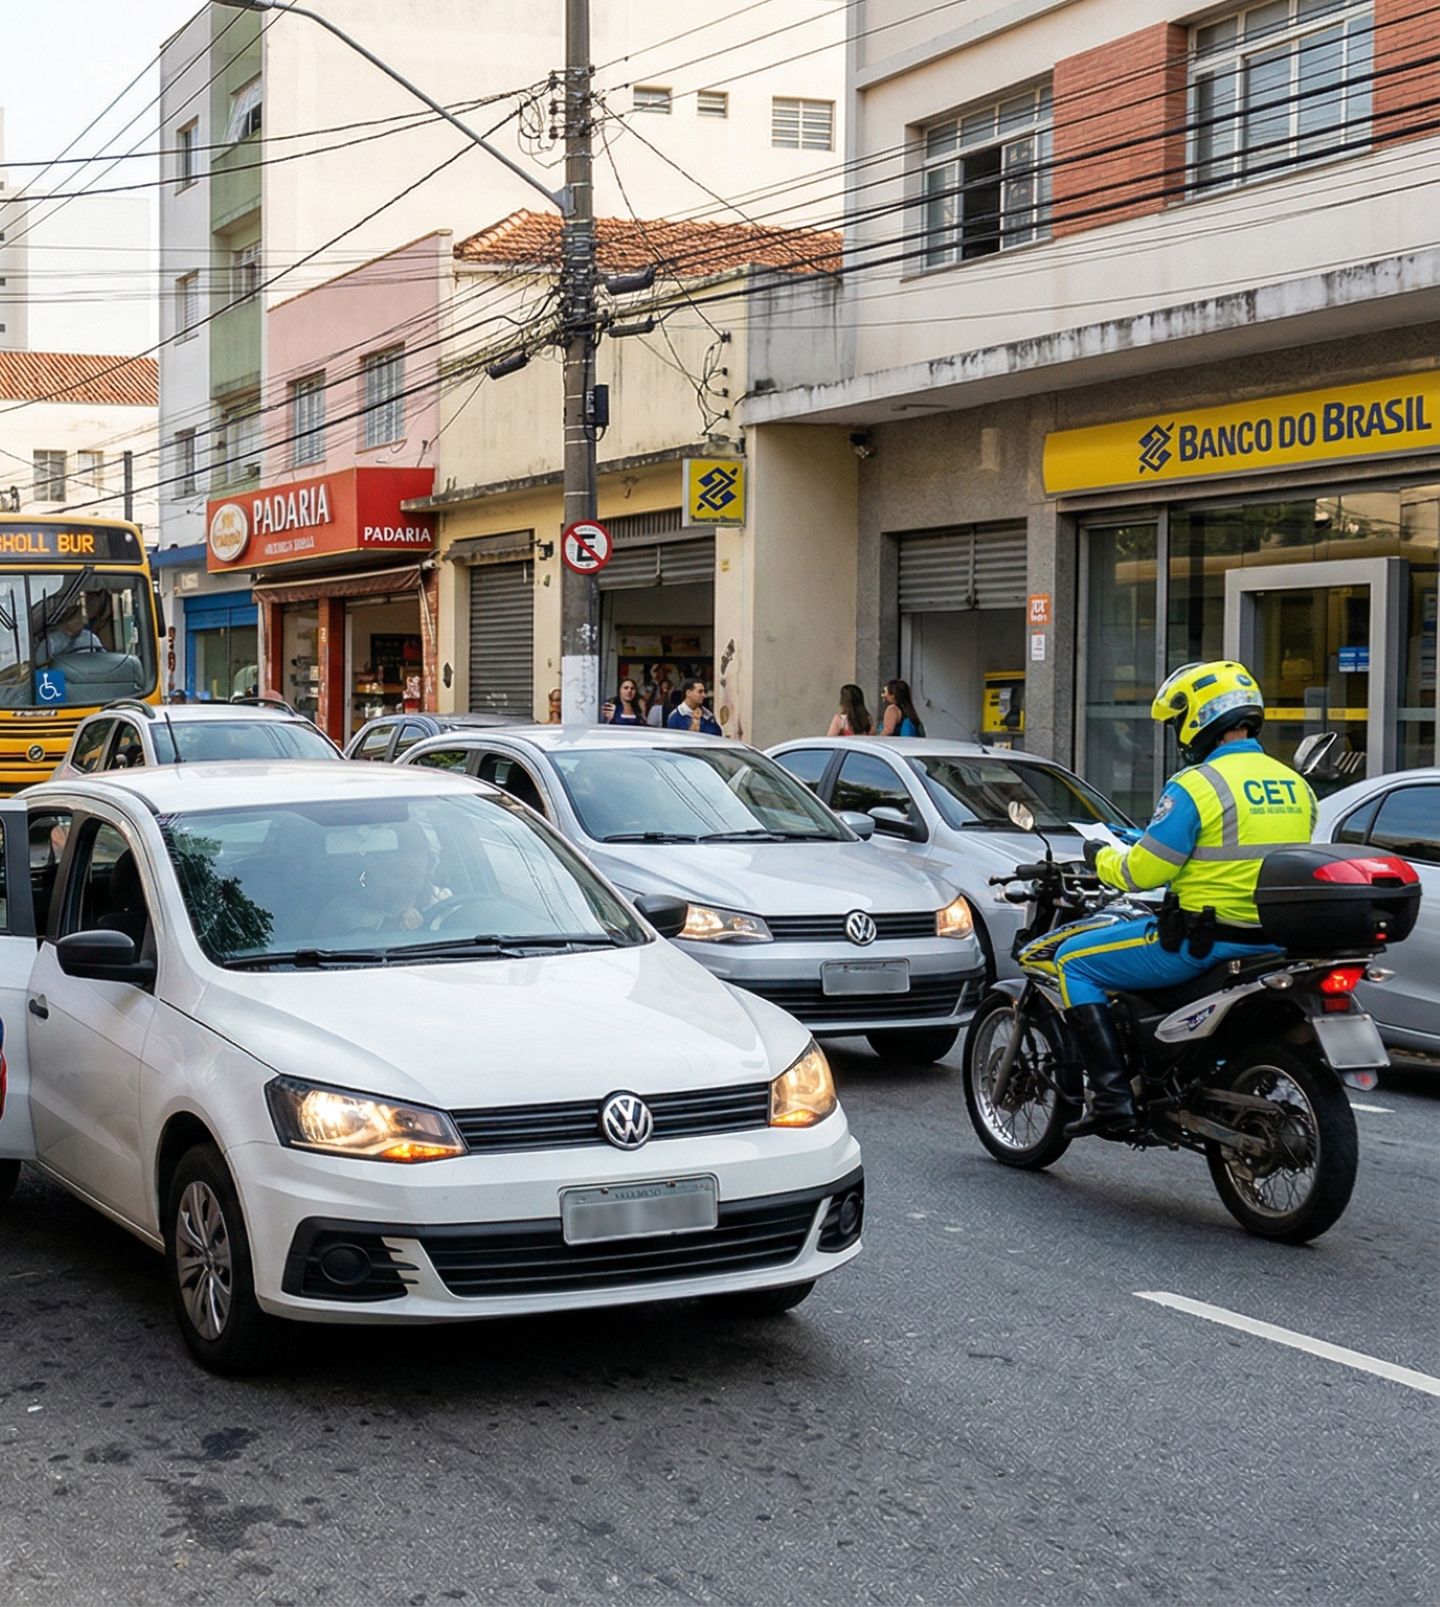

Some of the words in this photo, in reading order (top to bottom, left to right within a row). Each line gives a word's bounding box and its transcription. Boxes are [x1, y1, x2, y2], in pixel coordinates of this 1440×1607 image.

[1179, 418, 1272, 462] BANCO
[1279, 412, 1316, 449] DO
[1322, 395, 1433, 442] BRASIL
[252, 483, 331, 536] PADARIA
[57, 534, 95, 553] BUR
[363, 526, 432, 543] PADARIA
[1243, 779, 1297, 805] CET
